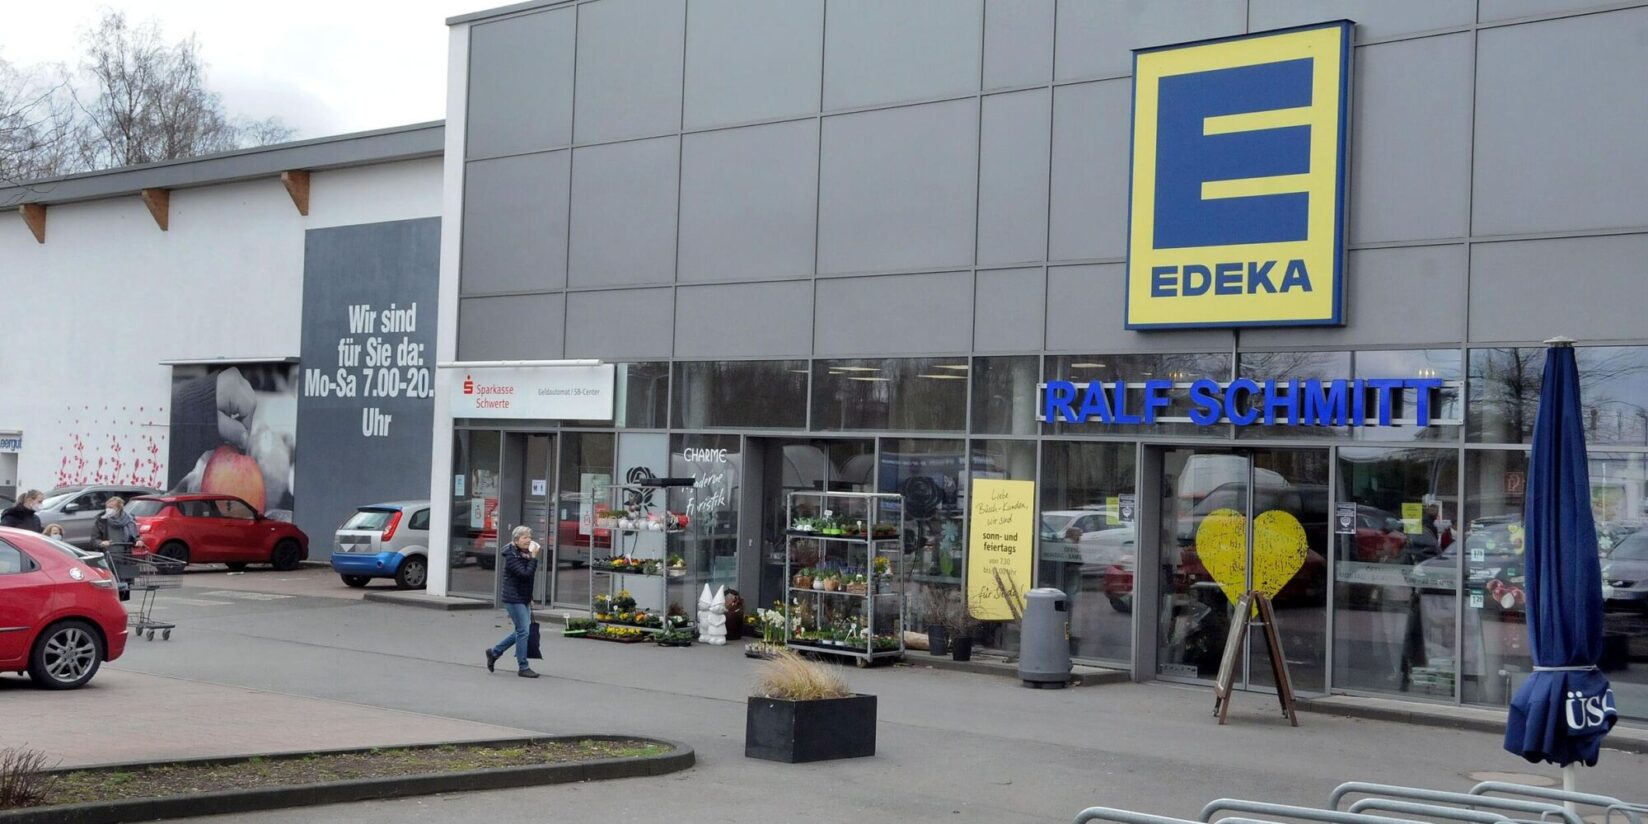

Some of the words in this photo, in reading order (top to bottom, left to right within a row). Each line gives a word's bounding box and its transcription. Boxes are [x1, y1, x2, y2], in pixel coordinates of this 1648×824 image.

[1151, 259, 1313, 298] EDEKA
[348, 304, 377, 334] Wir
[380, 302, 417, 333] sind
[338, 338, 361, 367] für
[365, 337, 391, 367] Sie
[396, 336, 424, 366] da:
[304, 368, 357, 397] Mo-Sa
[362, 367, 434, 398] 7.00-20.
[476, 384, 514, 397] Sparkasse
[538, 388, 571, 396] Geldautomat
[573, 388, 600, 396] SB-Center
[475, 398, 510, 409] Schwerte
[1044, 380, 1173, 425] RALF
[1188, 378, 1443, 428] SCHMITT
[362, 407, 392, 437] Uhr
[0, 437, 22, 451] eergut
[683, 447, 727, 463] CHARME
[681, 472, 724, 493] oderne
[982, 532, 1003, 540] sonn-
[1003, 532, 1018, 541] und
[983, 542, 1016, 555] feiertags
